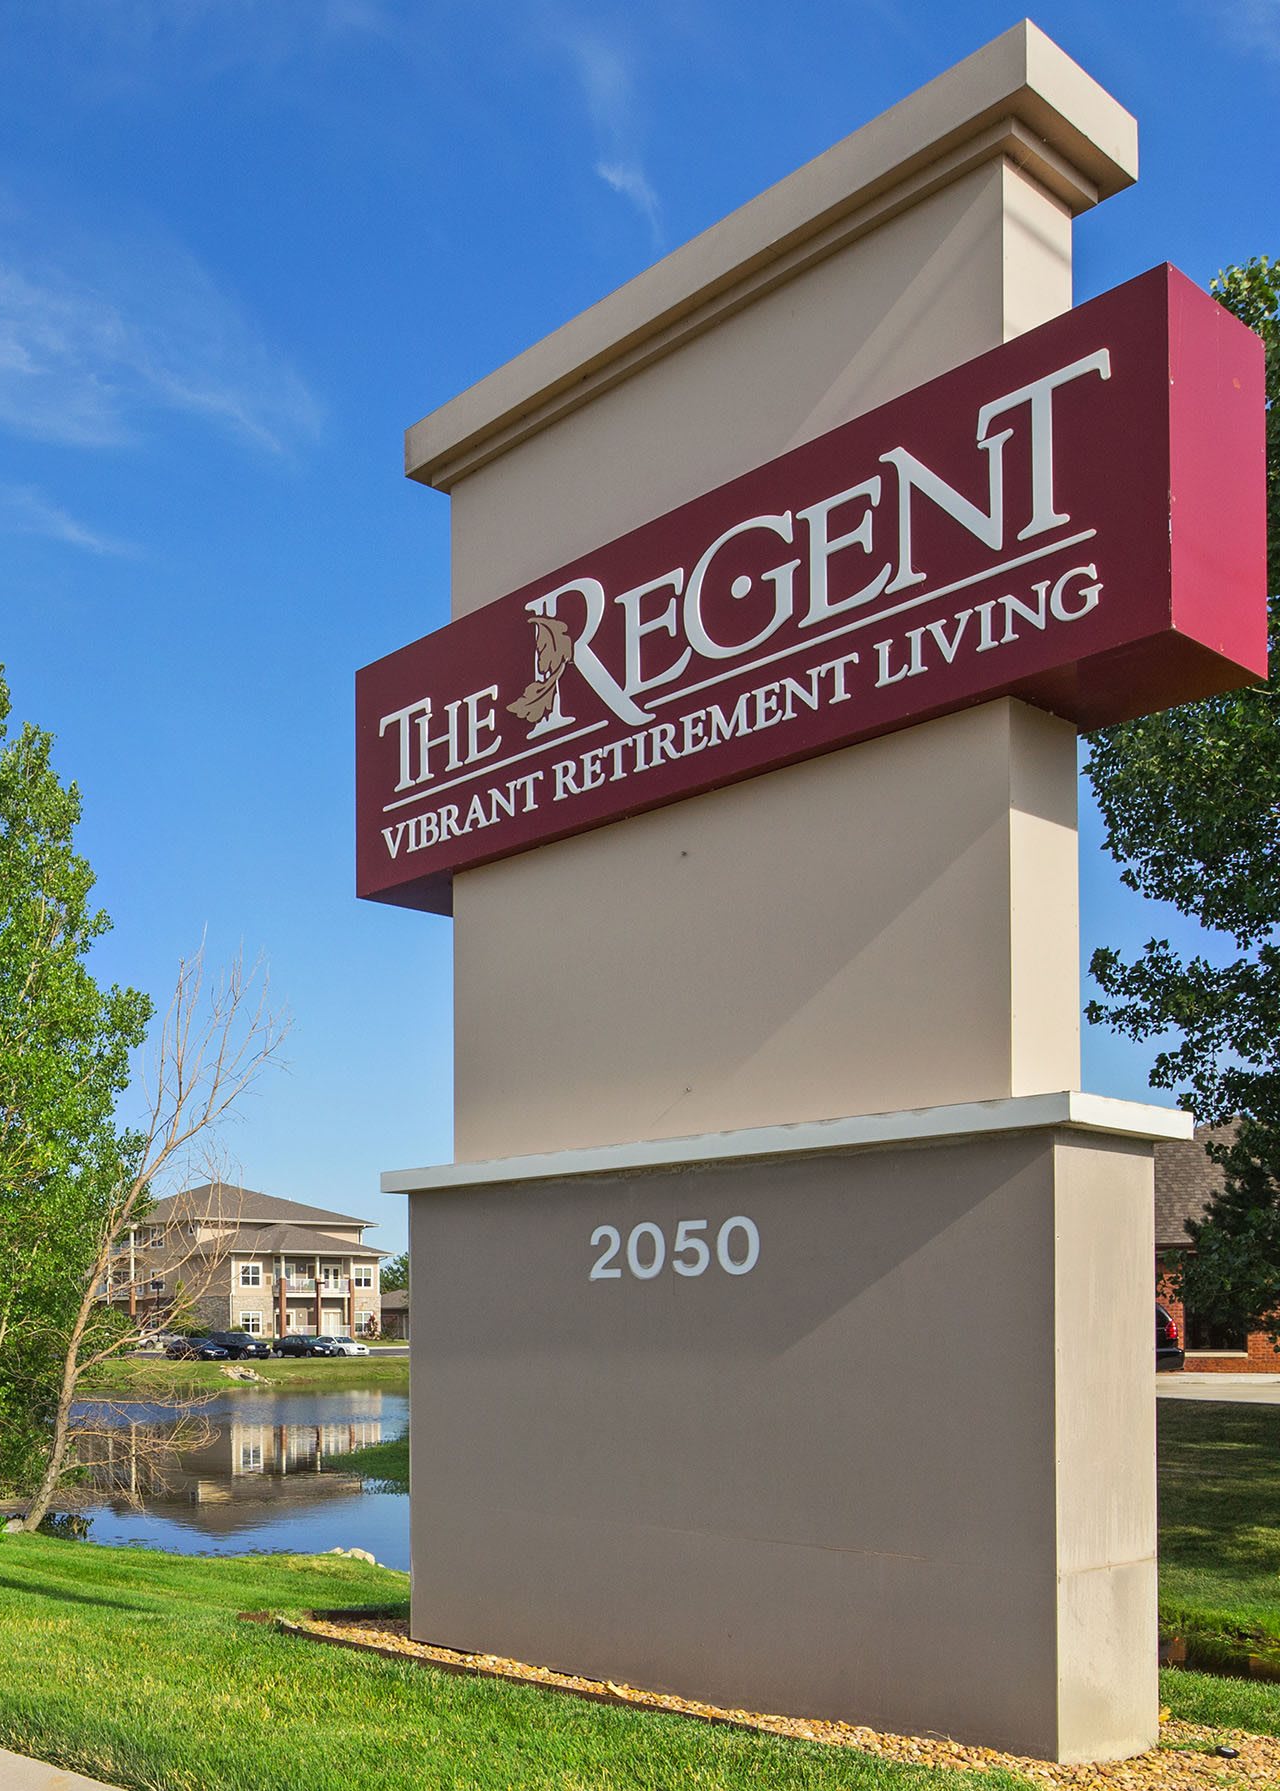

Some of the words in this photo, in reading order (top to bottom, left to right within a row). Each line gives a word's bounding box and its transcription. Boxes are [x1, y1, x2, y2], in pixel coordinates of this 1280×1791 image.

[380, 685, 501, 792] THE
[526, 348, 1111, 740] REGENT
[381, 772, 543, 859] VIBRANT
[553, 653, 859, 800] RETIREMENT
[874, 563, 1104, 688] LIVING
[589, 1215, 760, 1280] 2050
